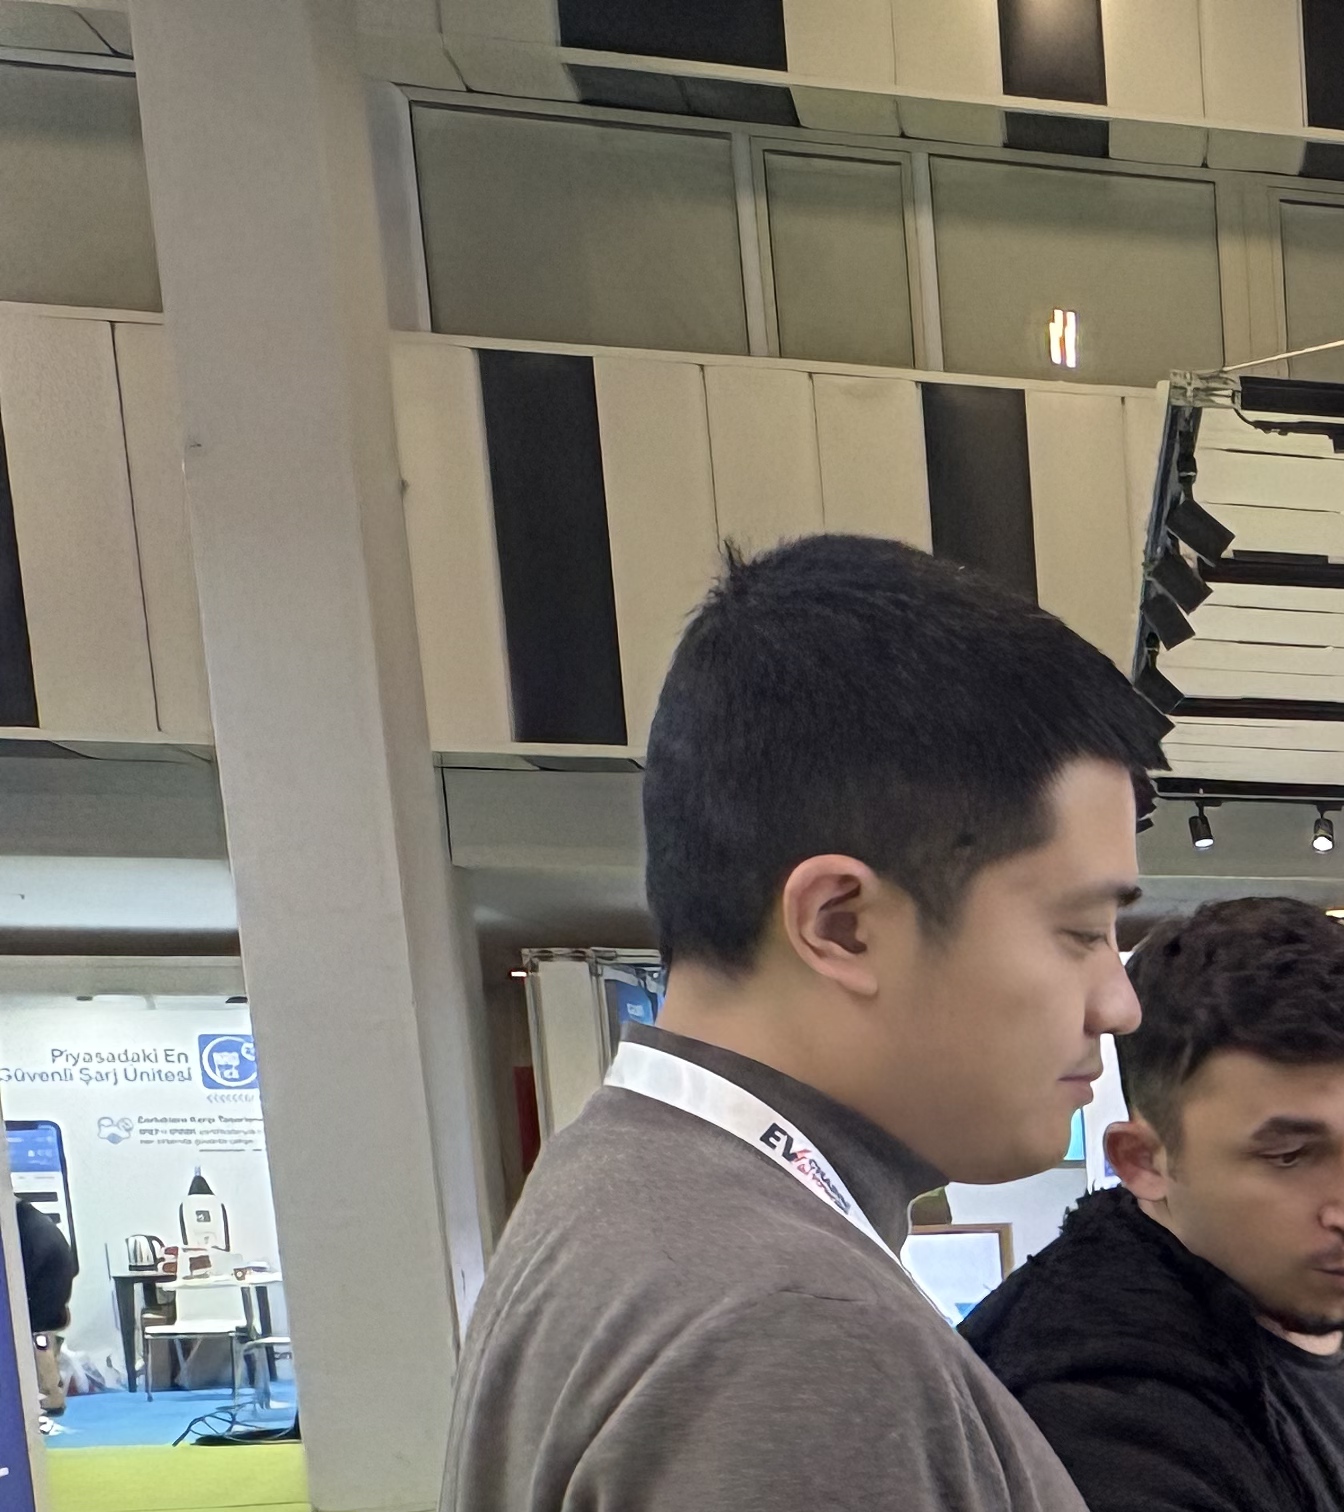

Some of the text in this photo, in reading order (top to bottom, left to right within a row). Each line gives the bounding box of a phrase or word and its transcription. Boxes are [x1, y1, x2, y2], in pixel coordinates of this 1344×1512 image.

[51, 1048, 189, 1067] Piyasadaki En
[0, 1067, 74, 1082] Güvenli
[79, 1067, 118, 1086] Şarj
[123, 1063, 193, 1082] Ünitesi
